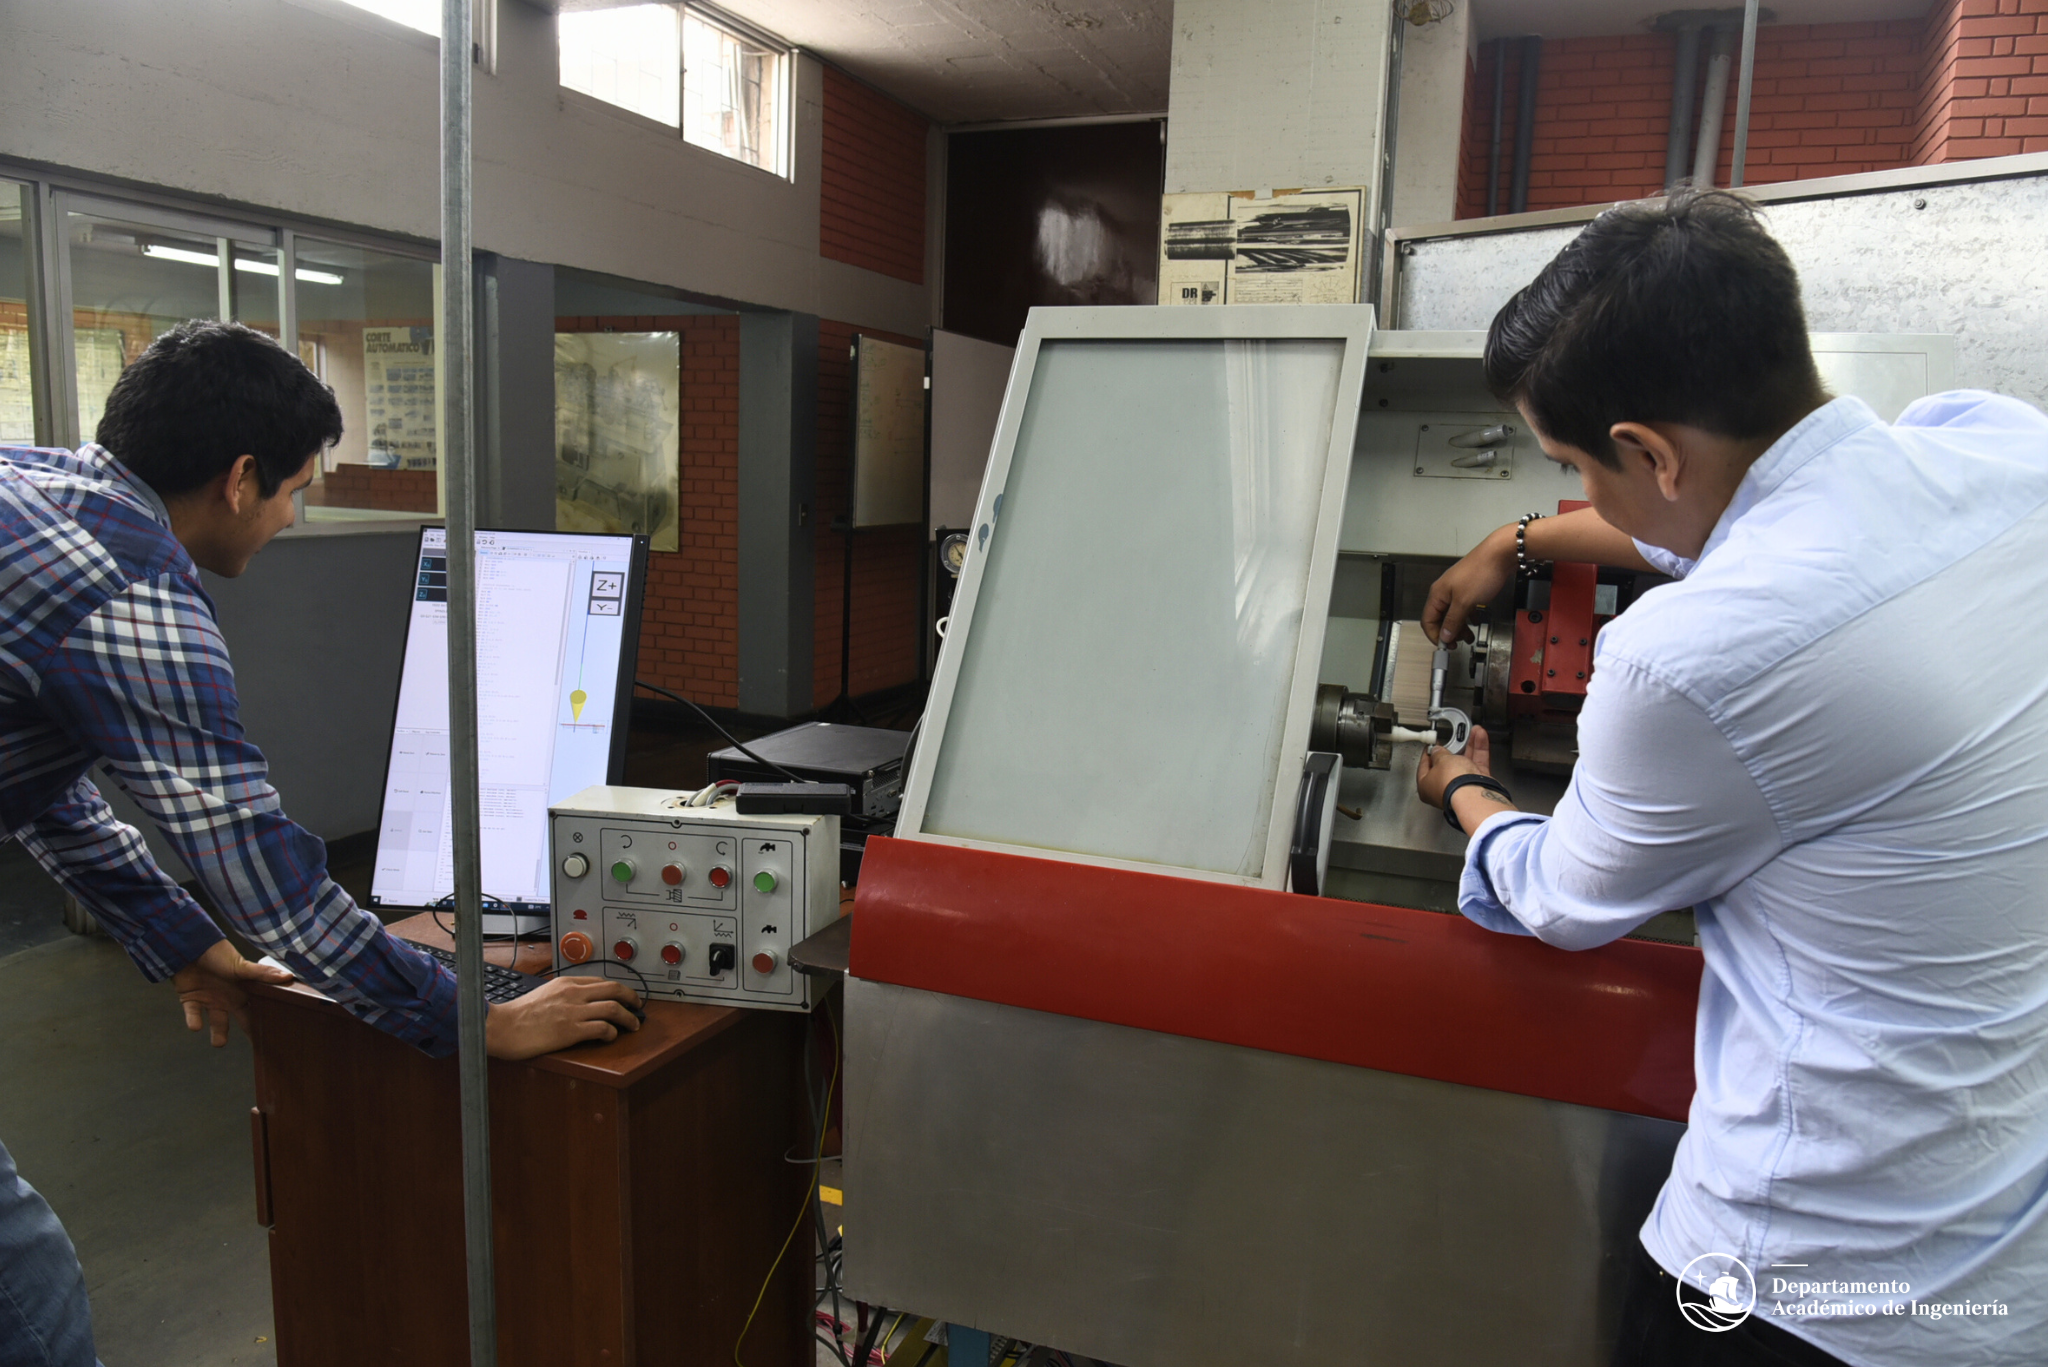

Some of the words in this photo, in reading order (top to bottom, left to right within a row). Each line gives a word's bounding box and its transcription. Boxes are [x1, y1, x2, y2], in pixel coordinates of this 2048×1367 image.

[366, 332, 391, 342] CORTE
[366, 342, 420, 353] AUTOMATICO
[596, 579, 617, 591] Z+
[596, 603, 613, 611] Y-
